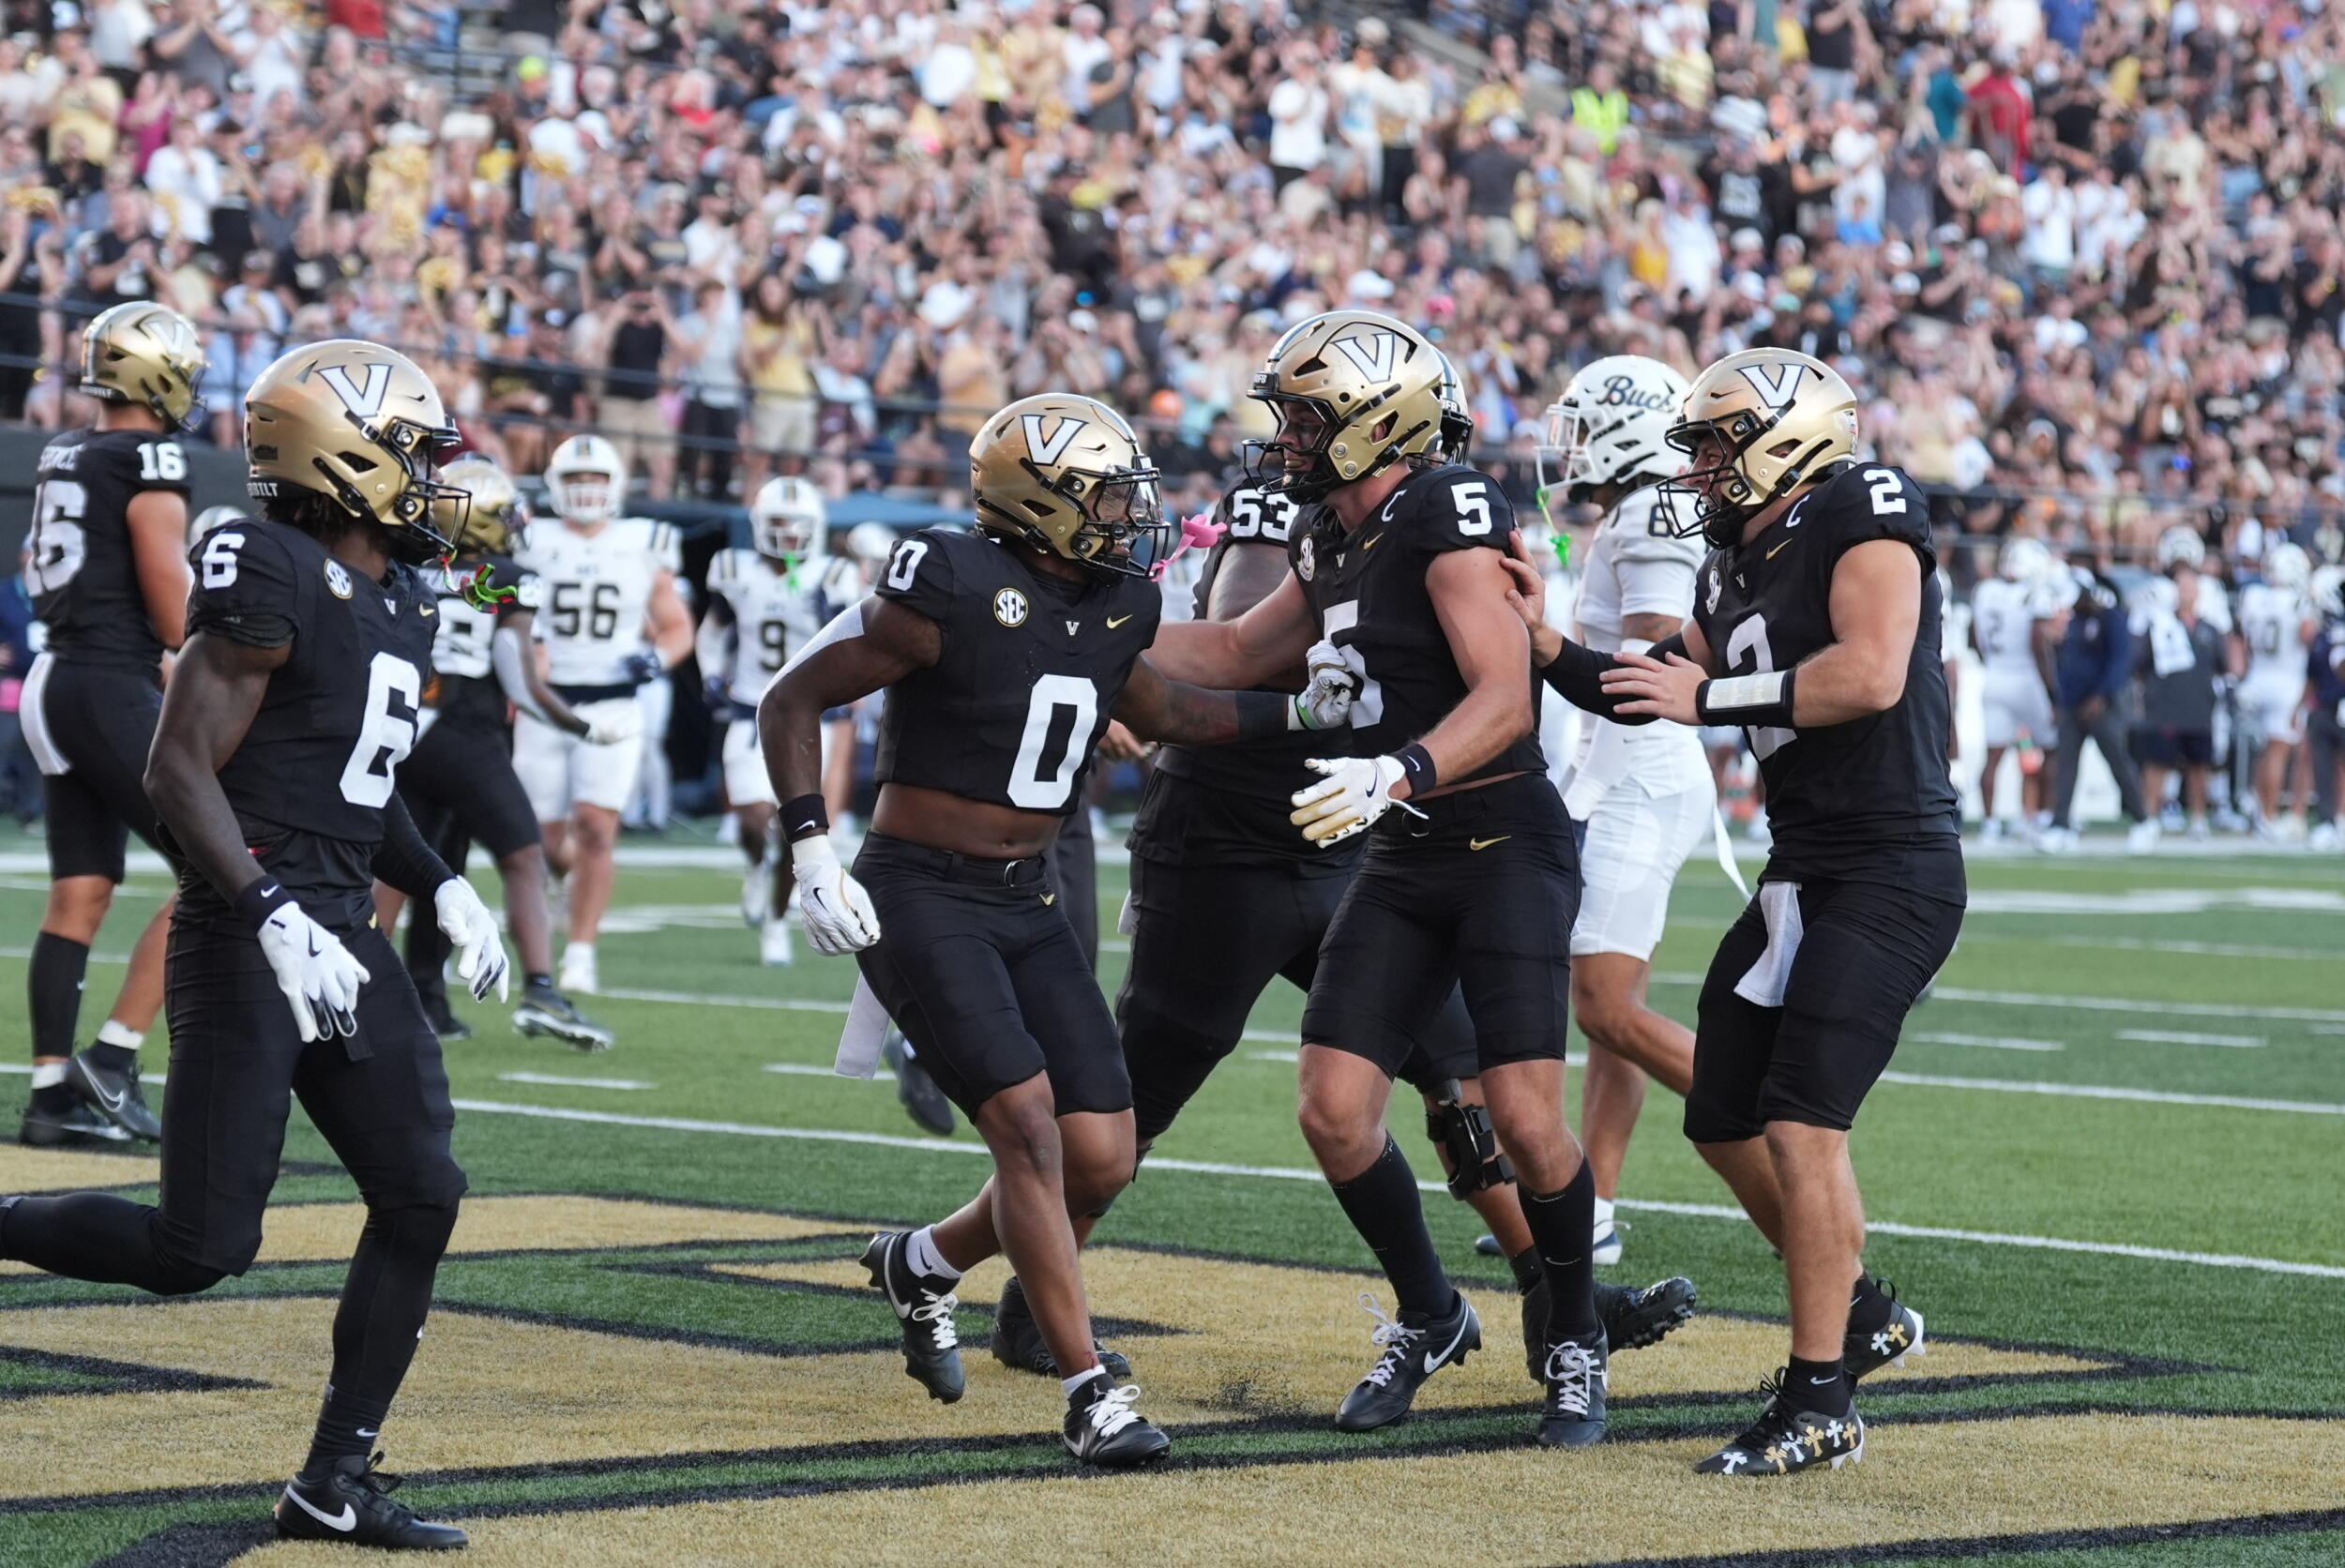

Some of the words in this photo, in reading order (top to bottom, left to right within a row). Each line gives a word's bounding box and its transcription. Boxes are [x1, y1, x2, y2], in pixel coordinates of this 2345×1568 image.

[1329, 332, 1396, 384] V
[313, 363, 393, 418] V
[1735, 363, 1806, 409] V
[137, 442, 188, 481] 16
[1021, 414, 1088, 467] V
[1230, 489, 1300, 542] 53
[1381, 489, 1407, 522] C
[1450, 481, 1492, 536] 5
[1863, 469, 1907, 516] 2
[202, 533, 246, 590] 6
[887, 539, 929, 592] 0
[552, 581, 621, 640] 56
[997, 590, 1025, 625] SEC
[1066, 620, 1080, 636] V
[759, 619, 786, 672] 9
[339, 651, 421, 809] 6
[1007, 673, 1097, 808] 0
